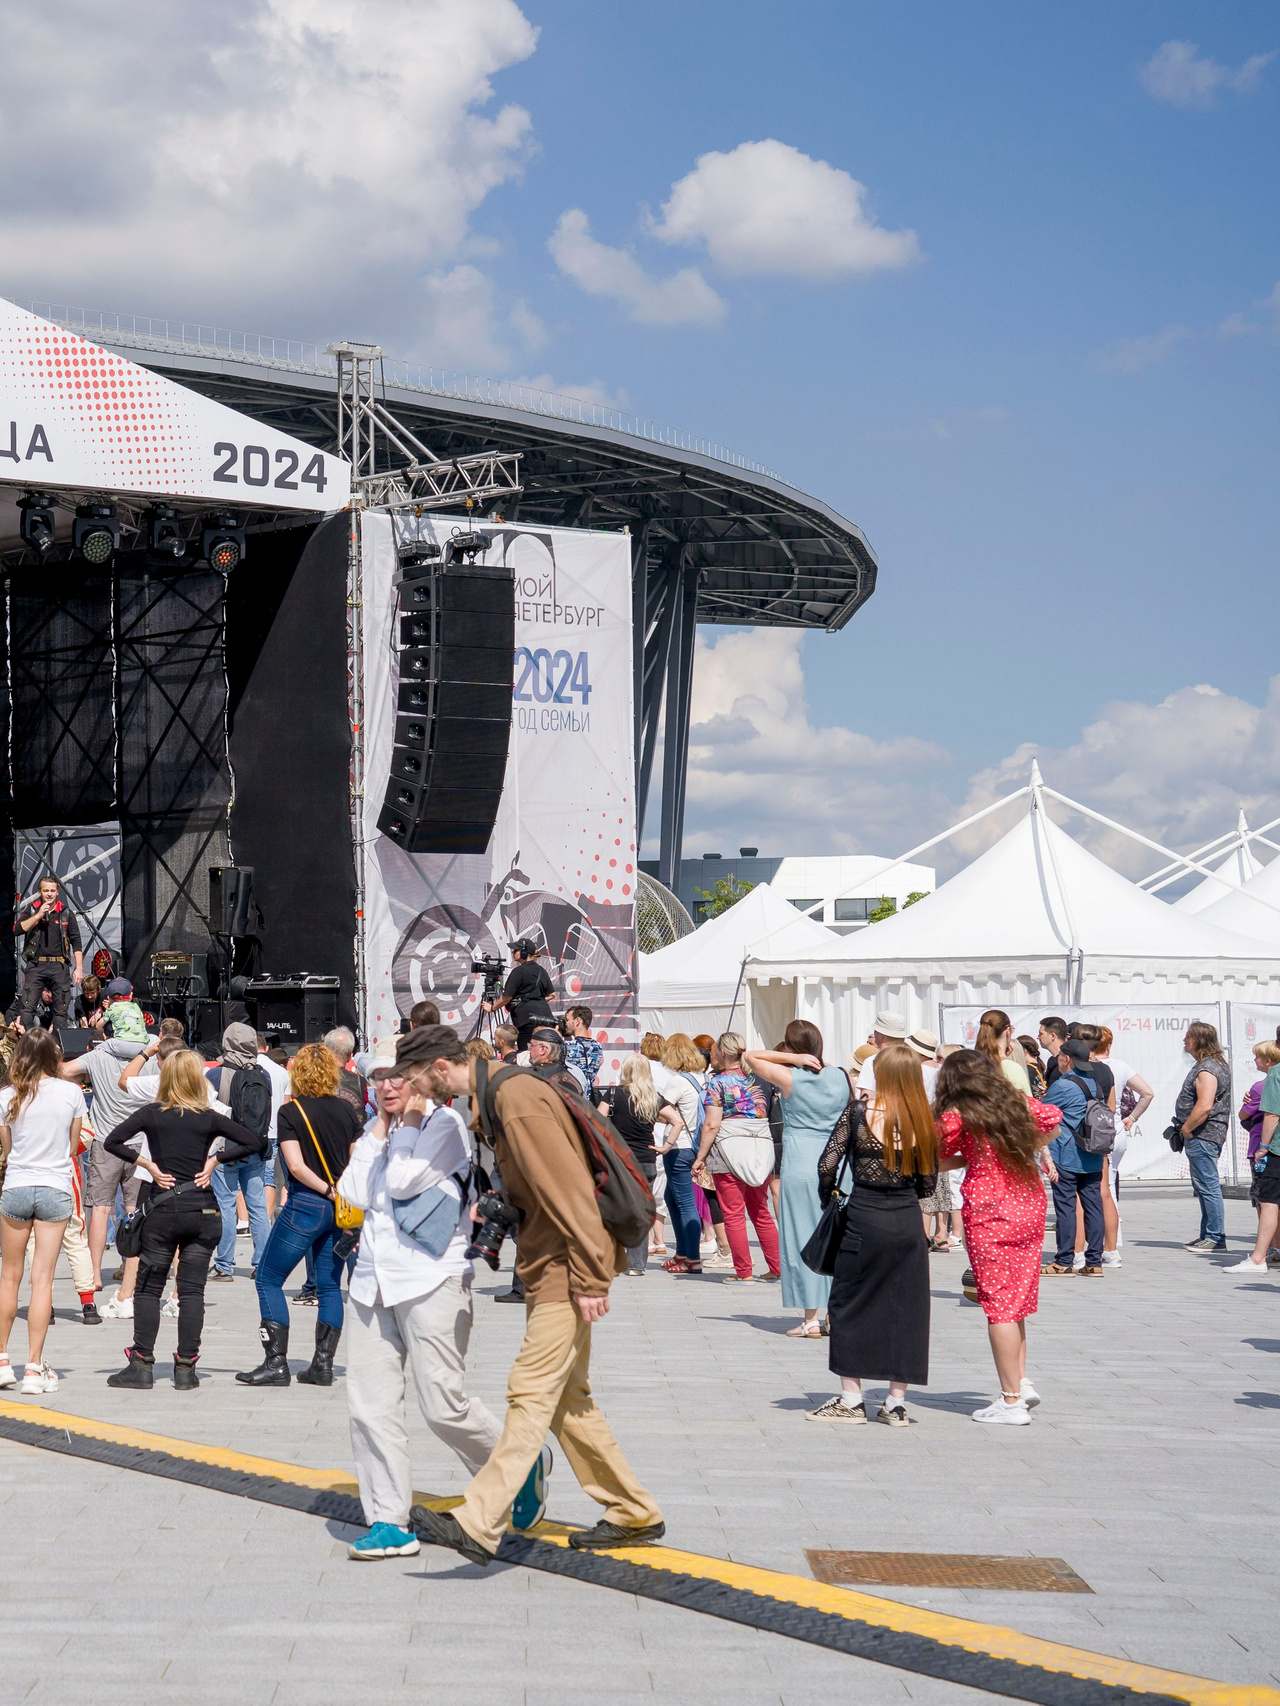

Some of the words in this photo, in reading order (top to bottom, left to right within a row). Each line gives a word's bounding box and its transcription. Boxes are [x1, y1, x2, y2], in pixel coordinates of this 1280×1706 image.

[213, 441, 328, 494] 2024
[513, 646, 593, 706] 2024
[1116, 1018, 1152, 1031] 12-14
[1155, 1017, 1200, 1031] ИЮЛ
